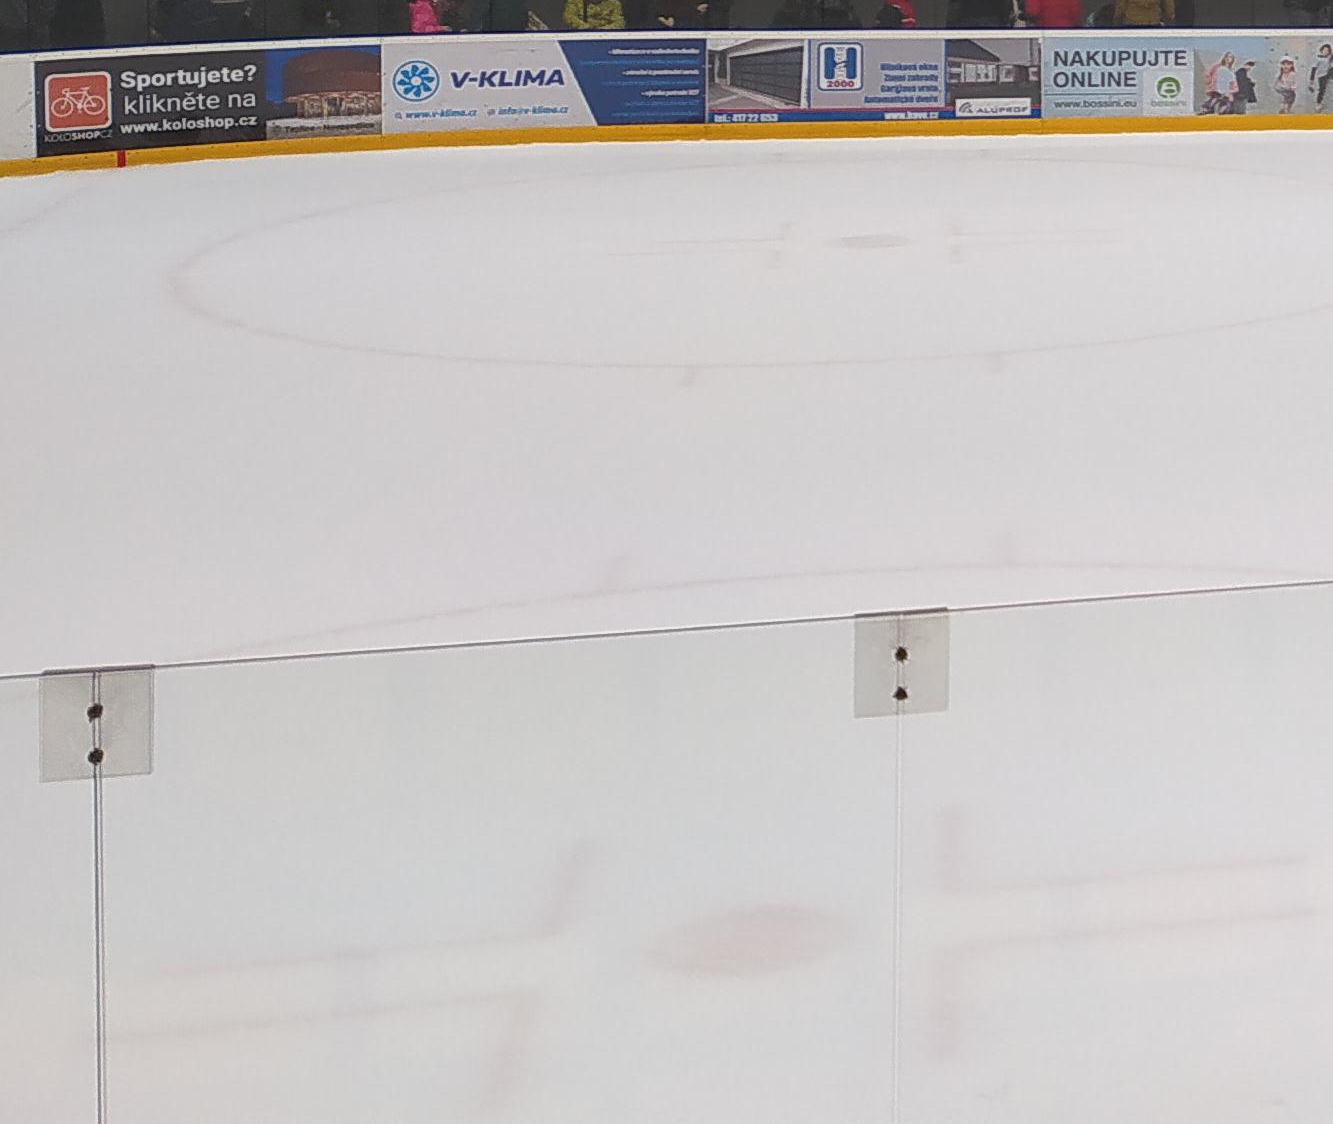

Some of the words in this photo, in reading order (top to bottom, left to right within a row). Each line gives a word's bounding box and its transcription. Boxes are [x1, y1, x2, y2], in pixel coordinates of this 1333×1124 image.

[1053, 50, 1187, 67] NAKUPUJTE
[120, 64, 257, 91] Sportujete?
[451, 69, 565, 88] V-KLIMA
[826, 79, 855, 88] 2000
[1053, 71, 1137, 88] ONLINE
[124, 92, 220, 115] klikněte
[228, 93, 256, 109] na
[1054, 99, 1137, 108] www.bossini.eu
[120, 115, 258, 134] www.koloshop.cz
